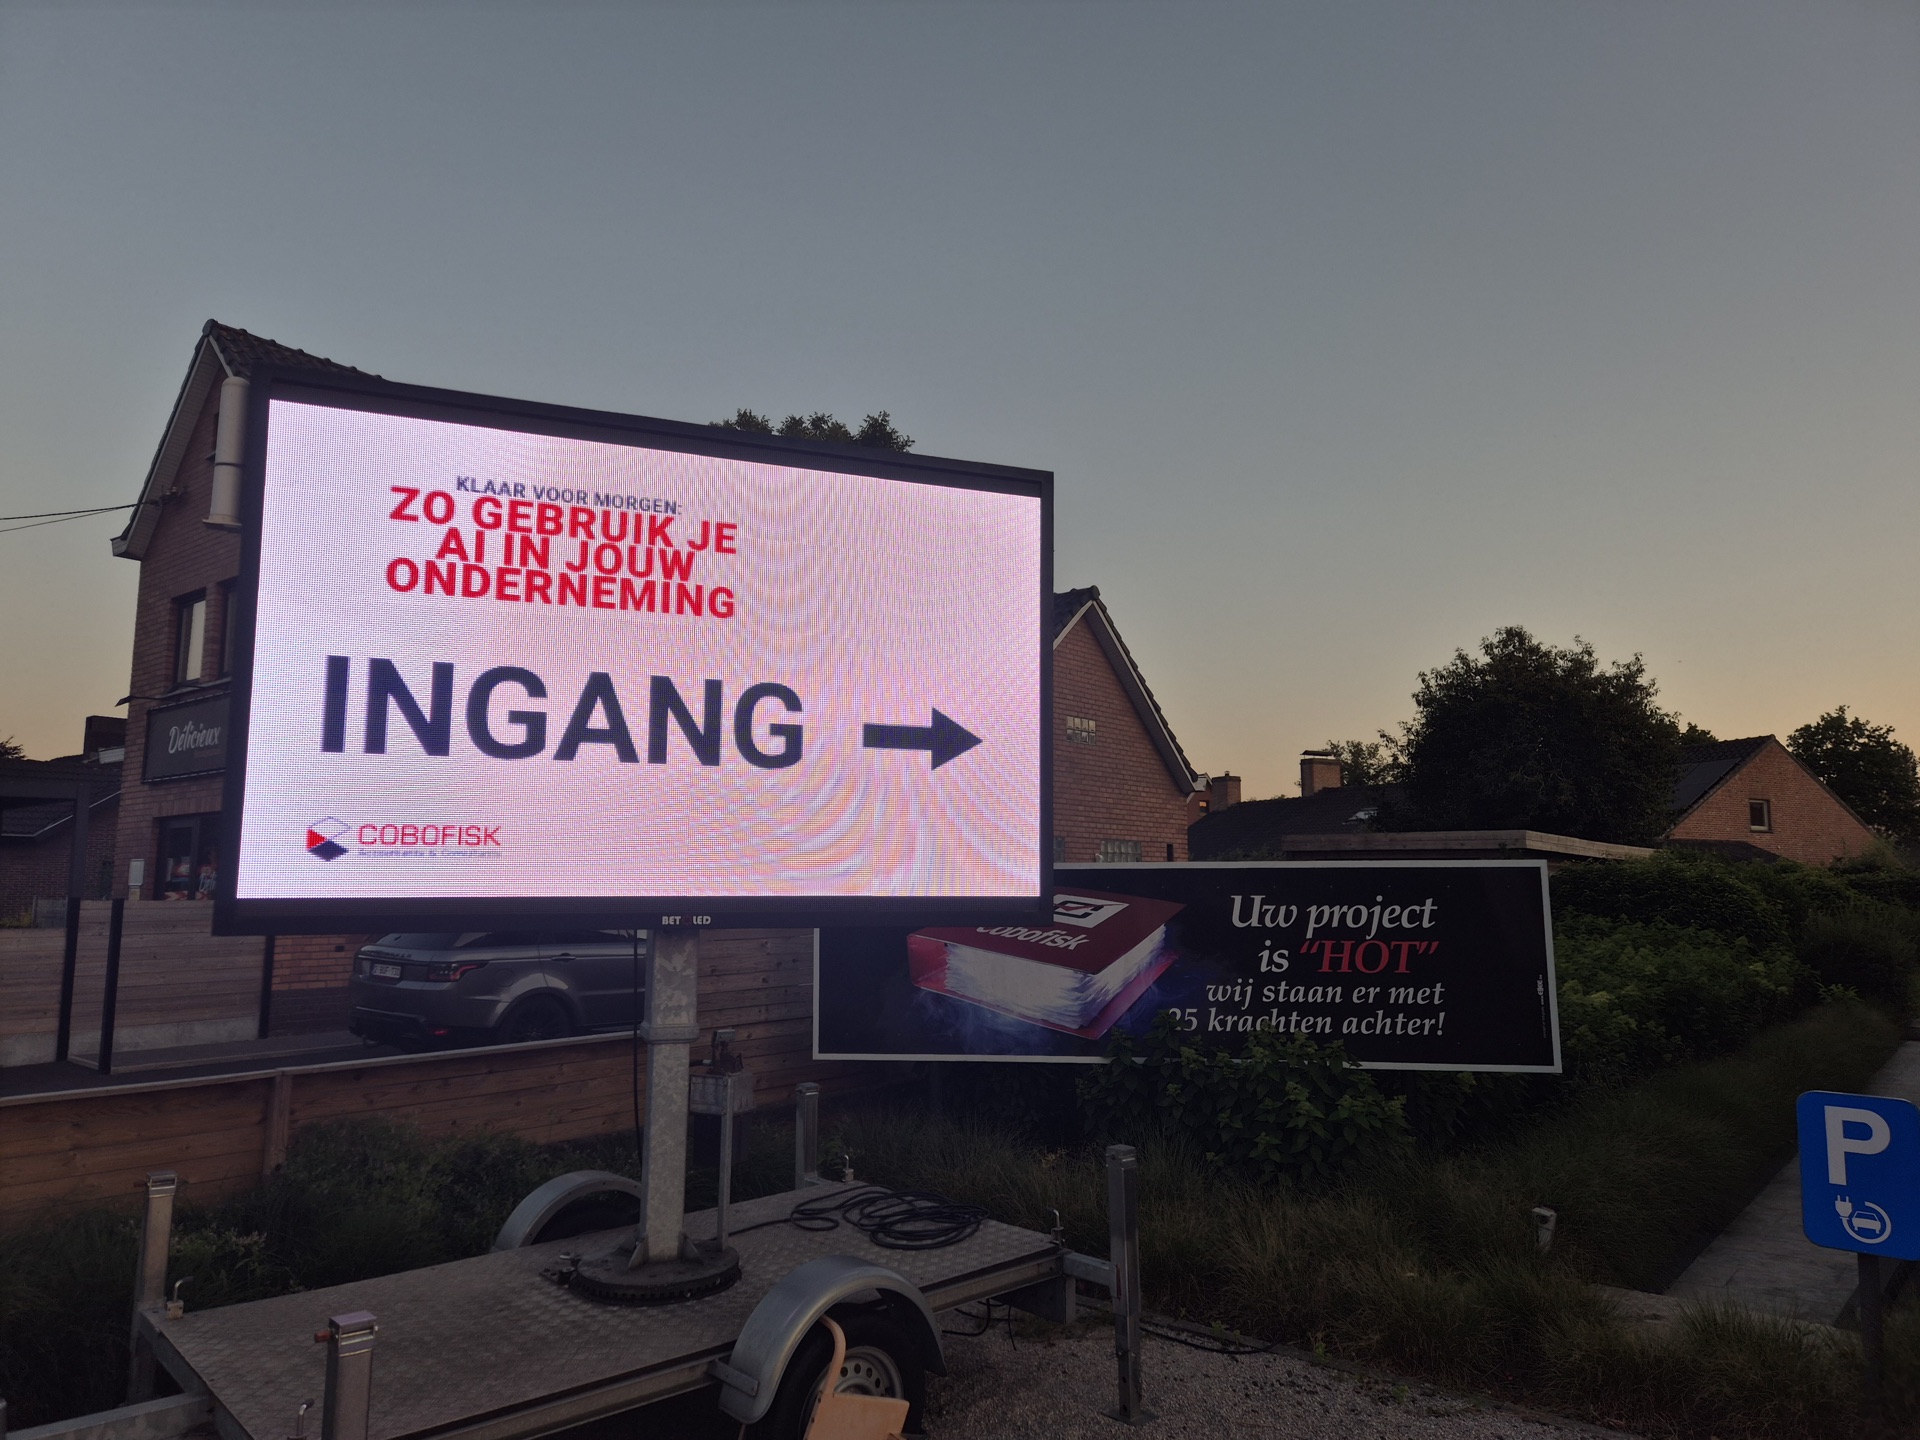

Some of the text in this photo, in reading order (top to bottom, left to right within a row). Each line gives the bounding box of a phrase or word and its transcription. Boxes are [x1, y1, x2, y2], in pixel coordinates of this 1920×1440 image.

[456, 475, 683, 515] KLAAR VOOR MORGEN:
[389, 486, 738, 555] ZO GEBRUIK JE
[436, 526, 696, 583] AI IN JOUW
[385, 557, 736, 620] ONDERNEMING
[321, 655, 804, 769] INGANG
[168, 720, 221, 754] Délicieux
[358, 823, 501, 846] COBOFISK
[1230, 894, 1438, 940] Uw project
[1258, 939, 1440, 974] is “HOT”
[1205, 978, 1446, 1010] wij staan er met
[1207, 1007, 1333, 1034] krachten
[1342, 1009, 1446, 1036] achter!
[1824, 1105, 1891, 1186] P
